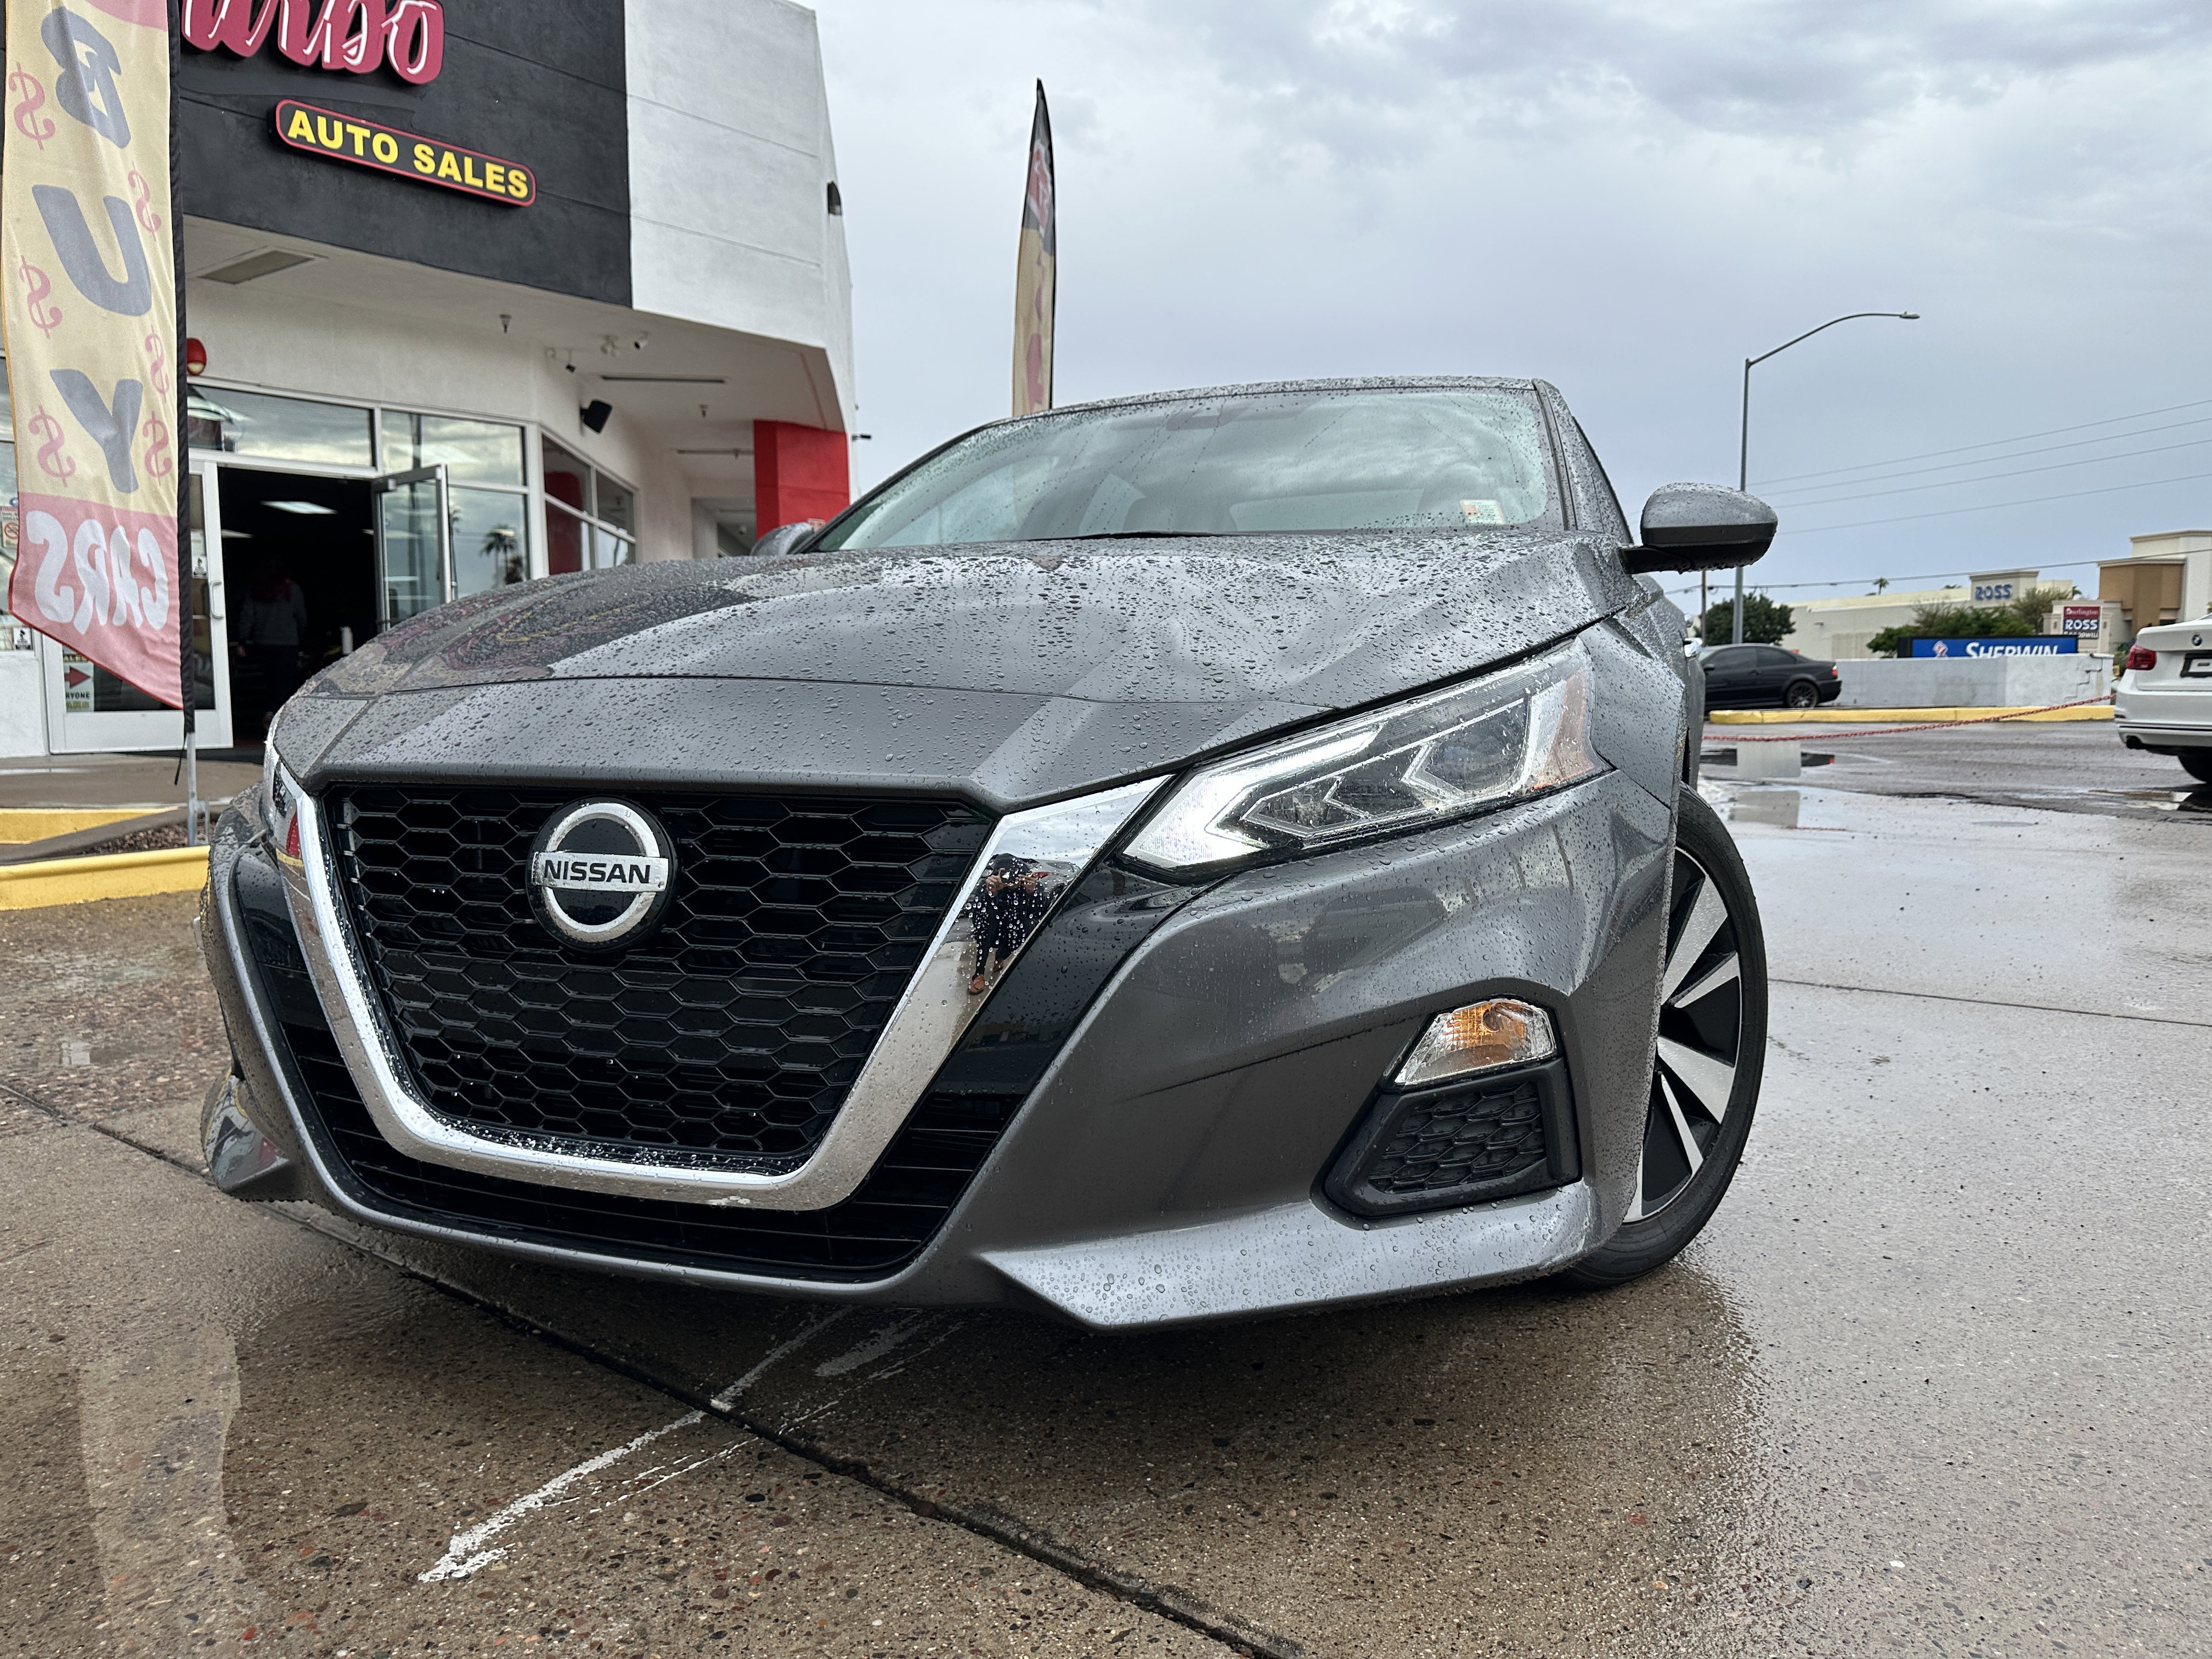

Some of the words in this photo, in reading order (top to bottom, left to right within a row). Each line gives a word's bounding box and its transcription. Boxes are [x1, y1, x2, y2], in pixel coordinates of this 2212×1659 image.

[287, 110, 398, 164] AUTO
[413, 143, 528, 200] SALES
[1976, 583, 2012, 601] ROSS
[2066, 607, 2098, 616] Burlington
[2065, 619, 2098, 630] ROSS
[544, 860, 650, 883] NISSAN
